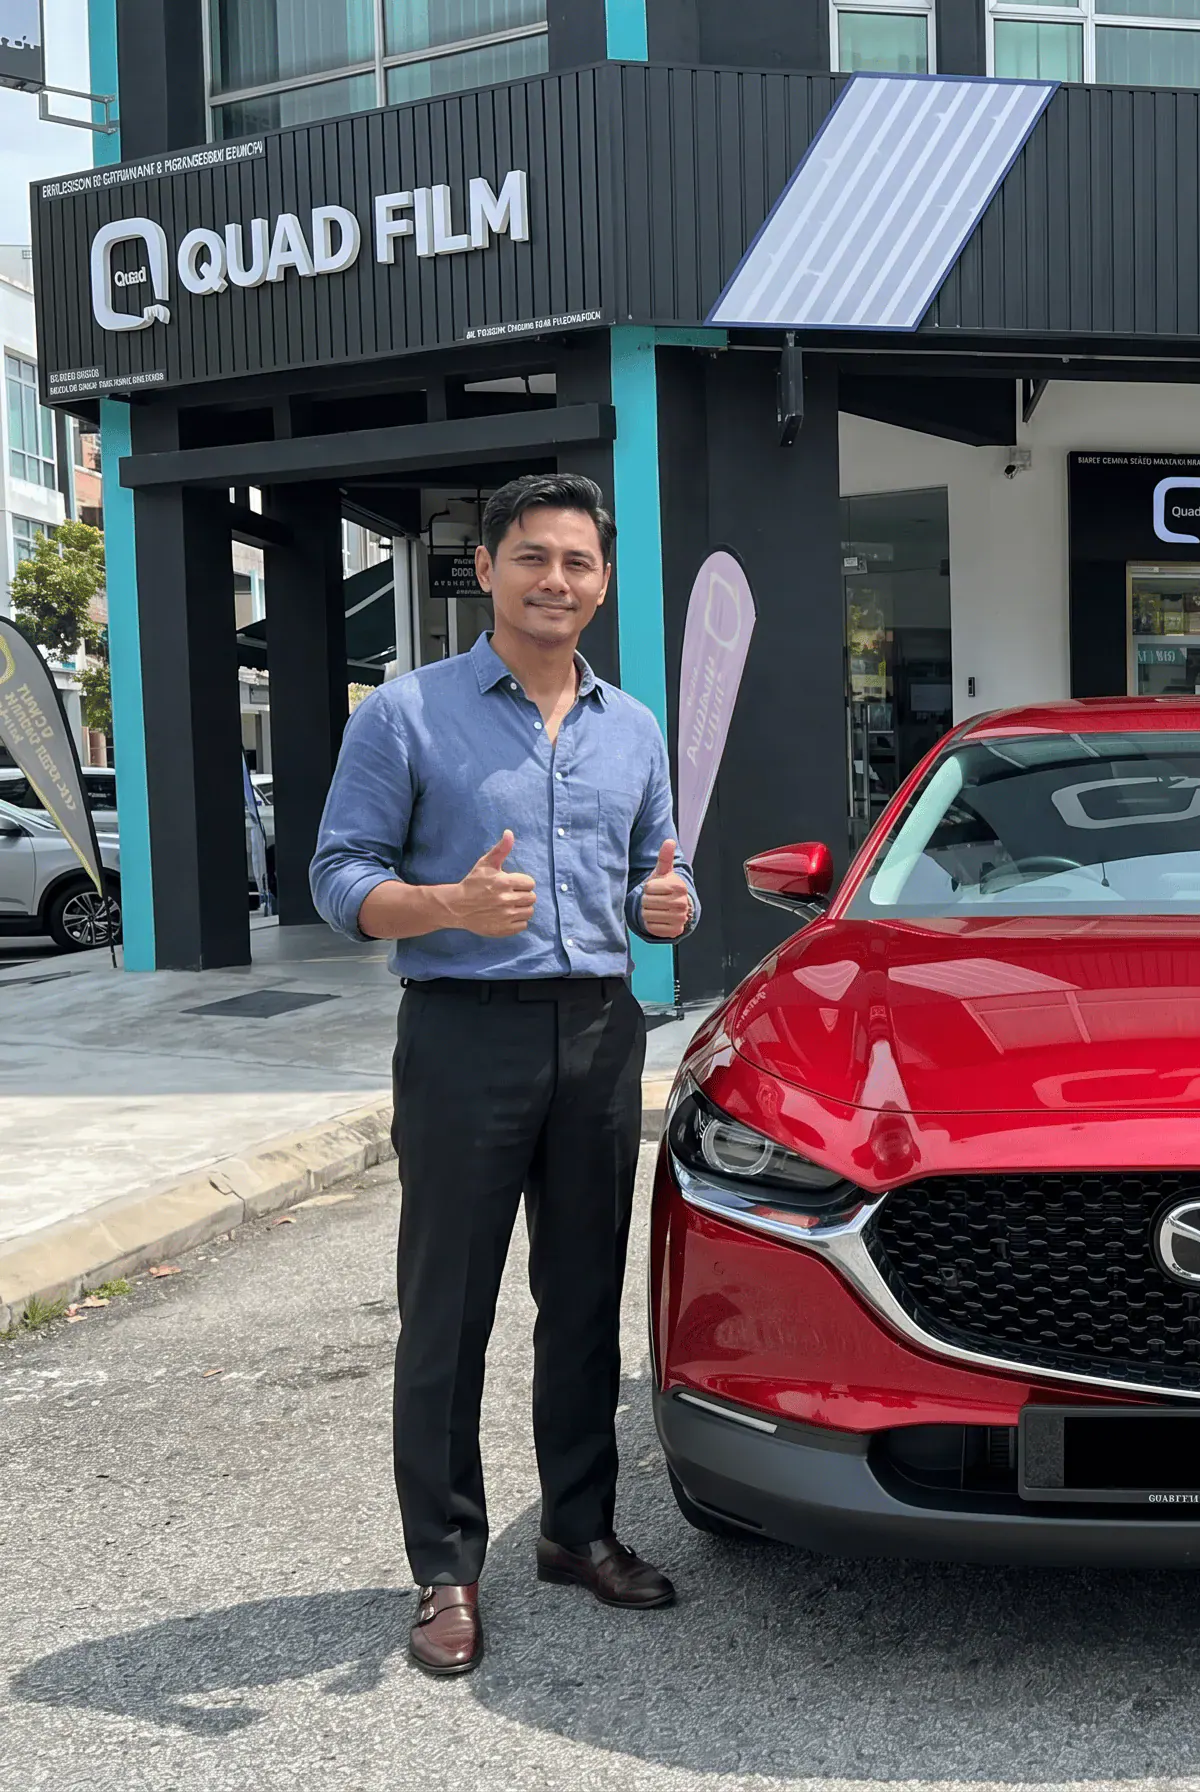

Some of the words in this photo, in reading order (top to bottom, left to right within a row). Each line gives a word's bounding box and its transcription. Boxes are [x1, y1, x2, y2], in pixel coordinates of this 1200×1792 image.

[177, 204, 361, 295] QUAD
[374, 169, 529, 265] FILM
[114, 266, 147, 287] Quad
